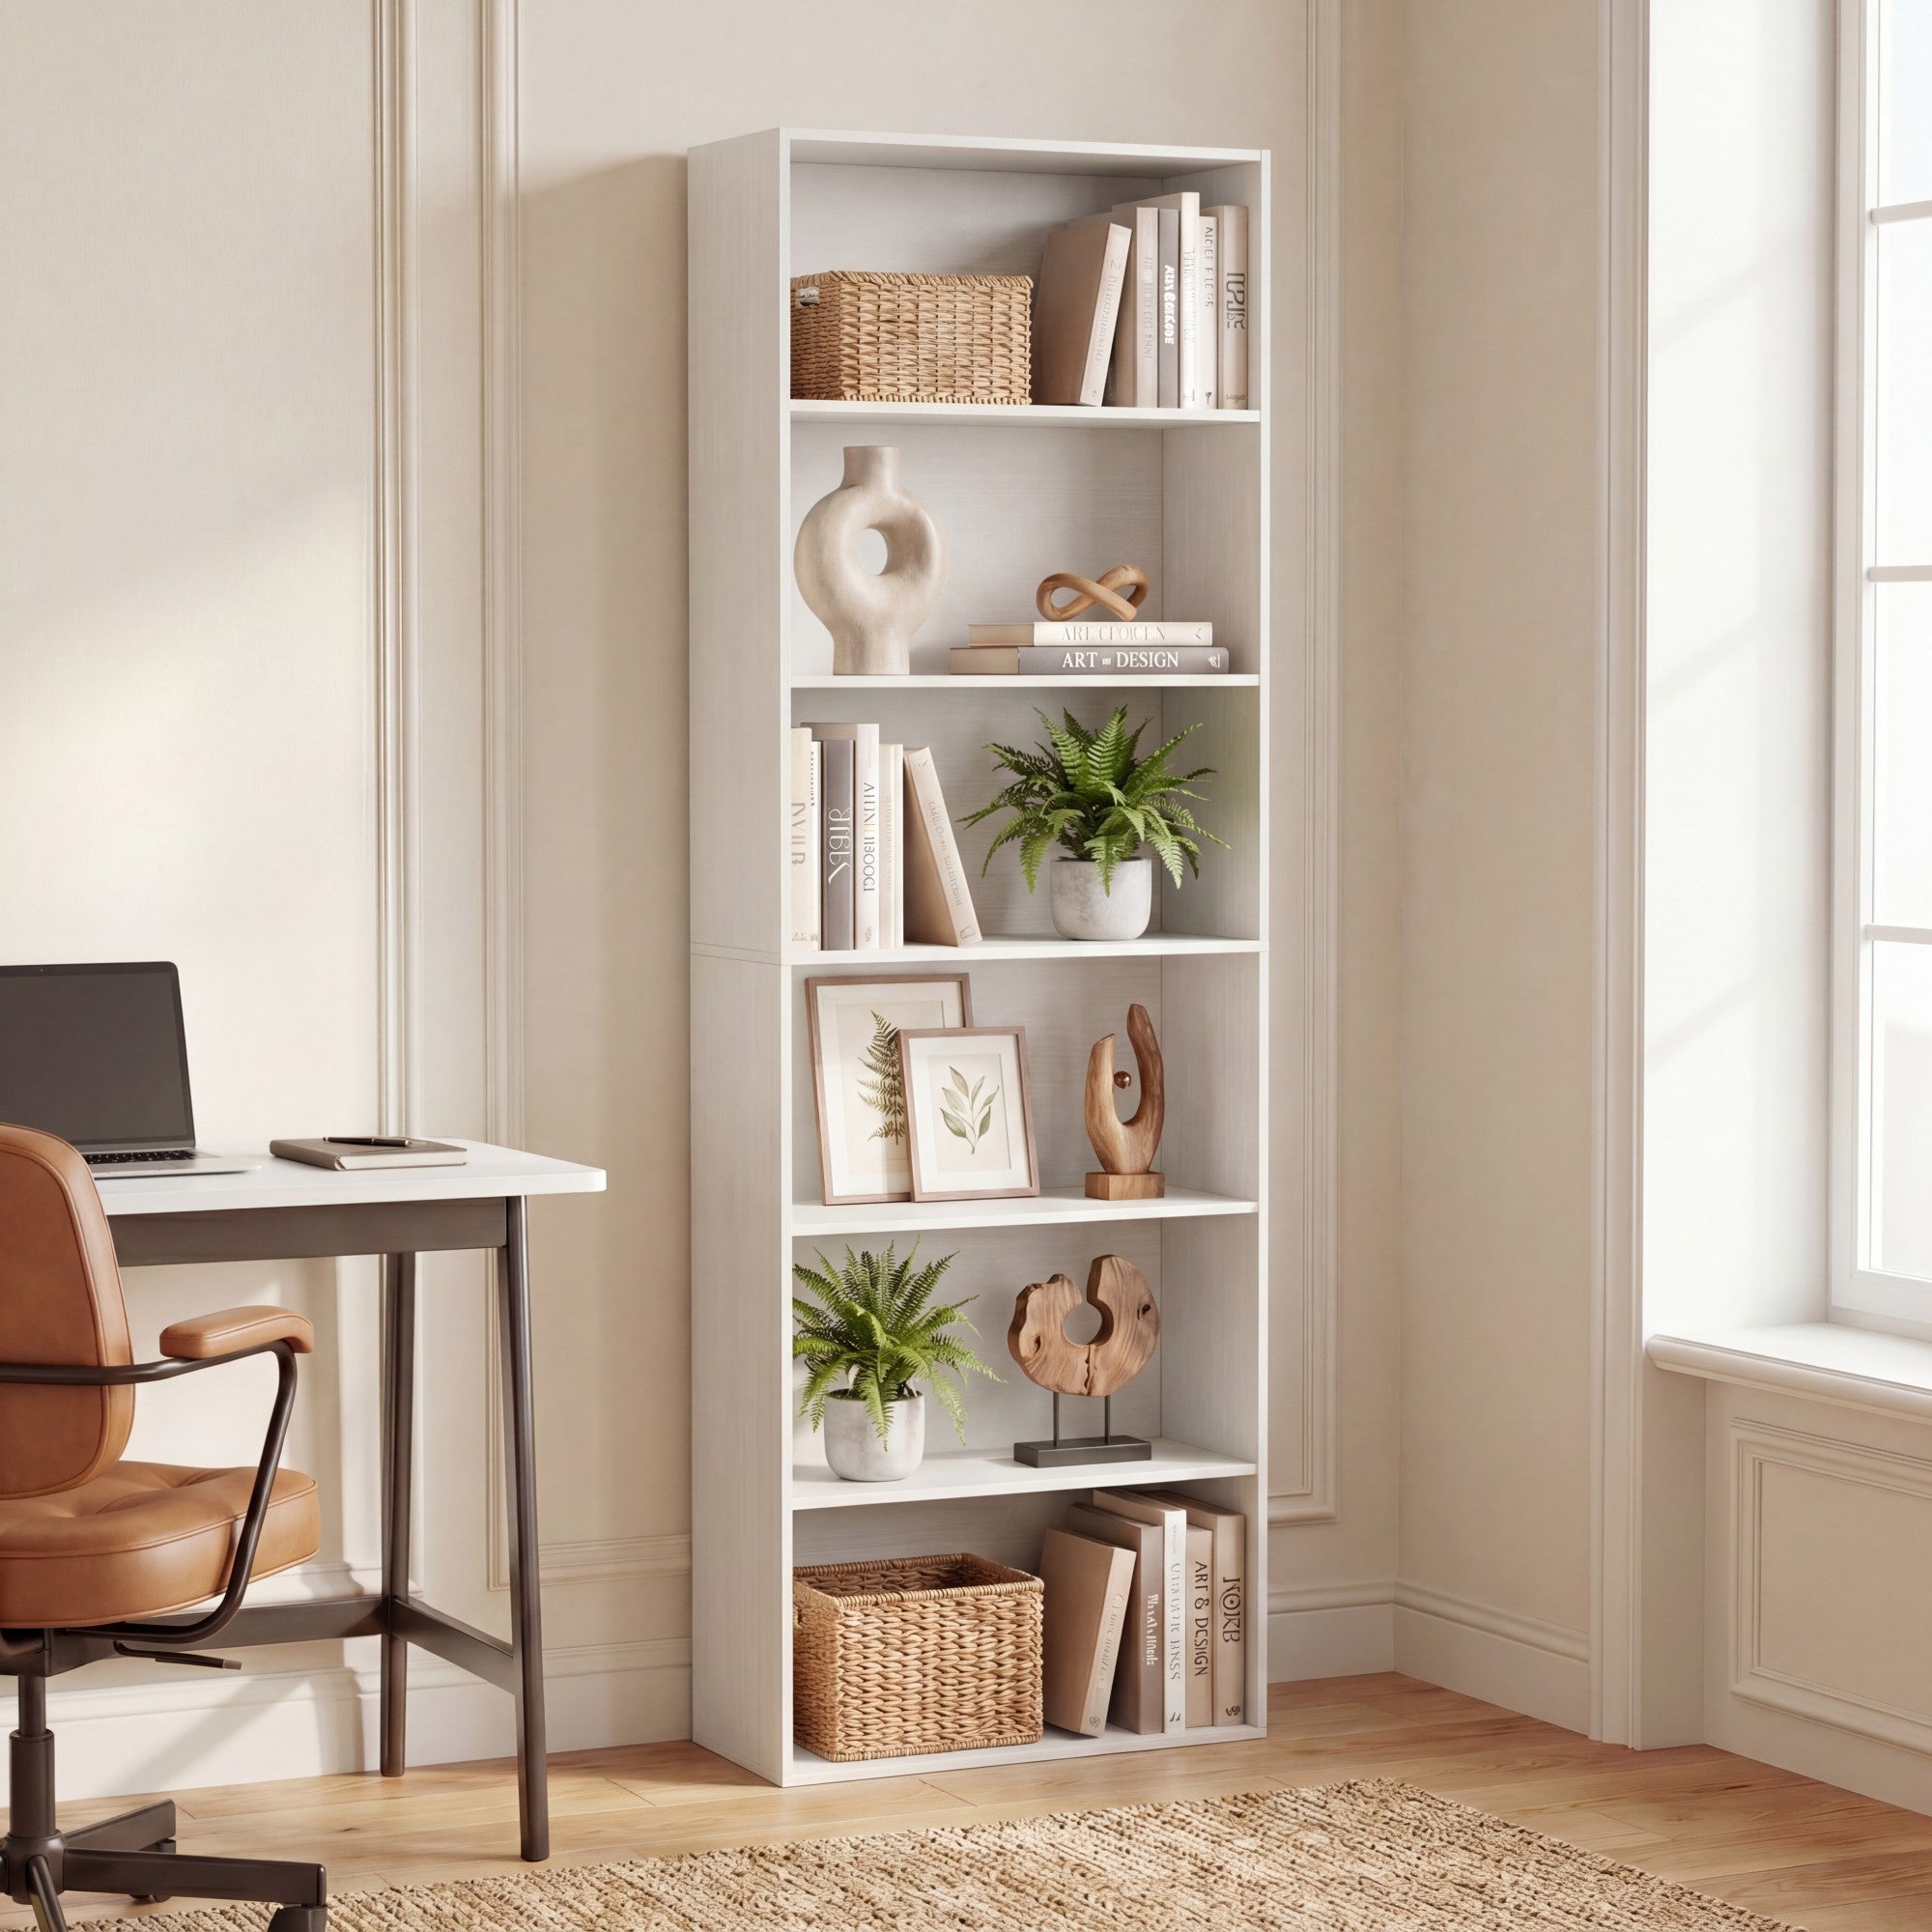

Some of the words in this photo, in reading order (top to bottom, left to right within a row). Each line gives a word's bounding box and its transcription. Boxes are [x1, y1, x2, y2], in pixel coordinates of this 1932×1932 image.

[1062, 651, 1098, 668] ART
[1116, 651, 1179, 668] DESIGN
[1195, 1560, 1208, 1591] ART
[1194, 1597, 1209, 1610] &
